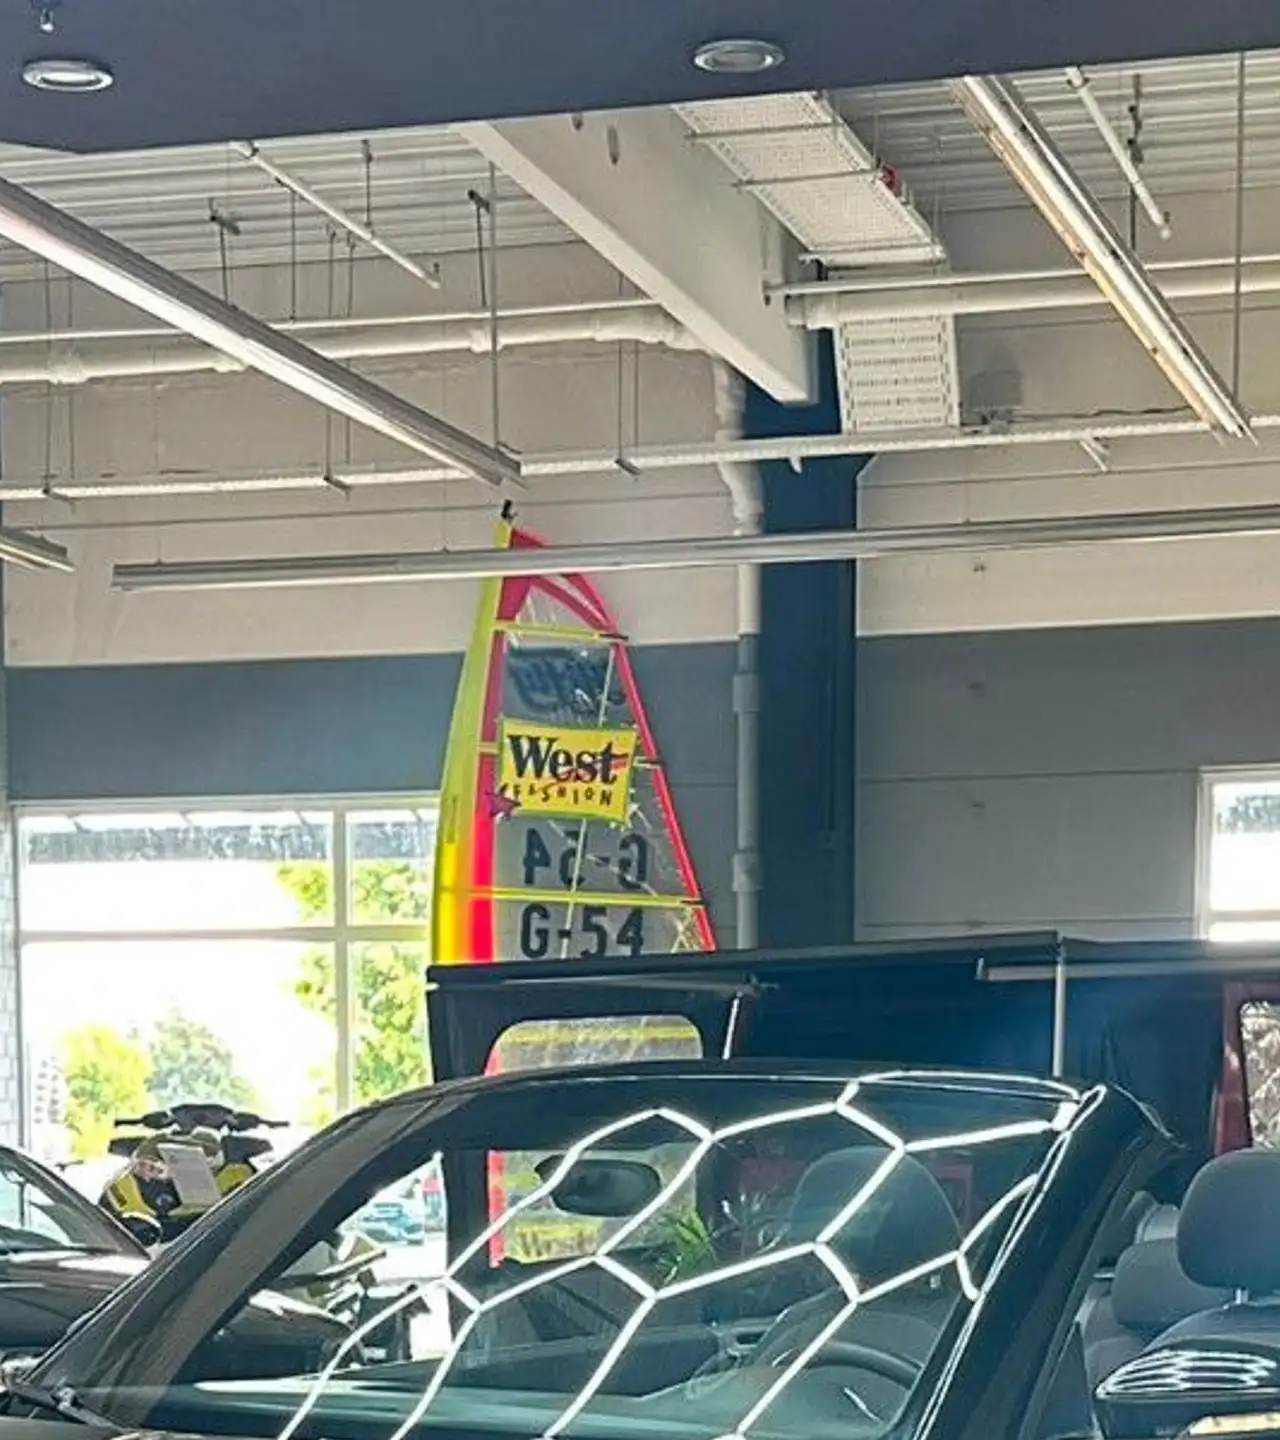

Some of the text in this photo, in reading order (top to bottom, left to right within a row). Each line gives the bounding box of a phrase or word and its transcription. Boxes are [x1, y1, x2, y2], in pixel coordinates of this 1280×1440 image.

[507, 733, 629, 785] West
[513, 783, 613, 807] FASHION
[521, 903, 644, 959] G-54
